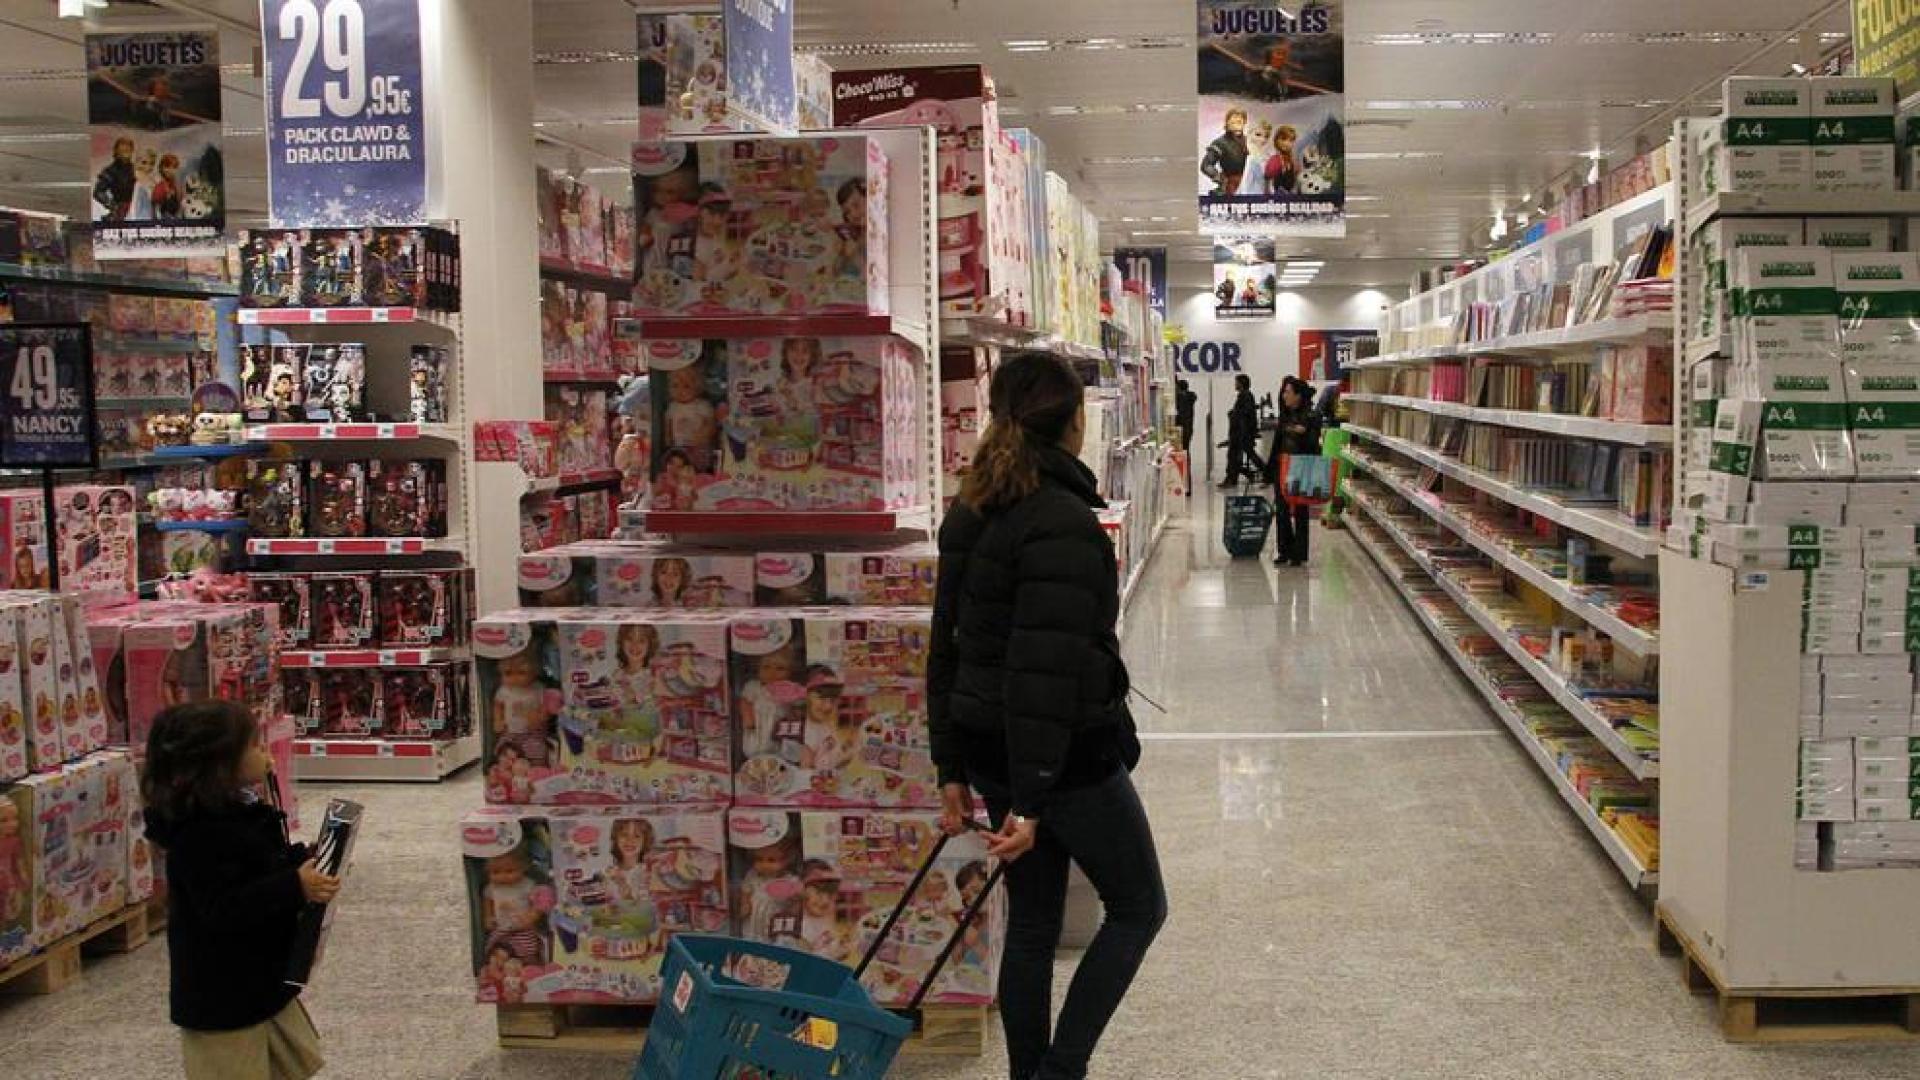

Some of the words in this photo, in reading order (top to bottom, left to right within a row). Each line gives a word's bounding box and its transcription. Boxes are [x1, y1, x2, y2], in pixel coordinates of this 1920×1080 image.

[101, 41, 204, 65] JUGUETES
[285, 127, 328, 144] PACK
[331, 125, 393, 142] CLAWD
[396, 124, 411, 140] &
[1736, 123, 1764, 138] A4
[1816, 121, 1845, 138] A4
[286, 145, 412, 164] DRACULAURA
[1754, 294, 1782, 309] A4
[1768, 407, 1797, 422] A4
[1856, 407, 1886, 422] A4
[13, 416, 82, 433] NANCY
[1792, 530, 1815, 541] A4
